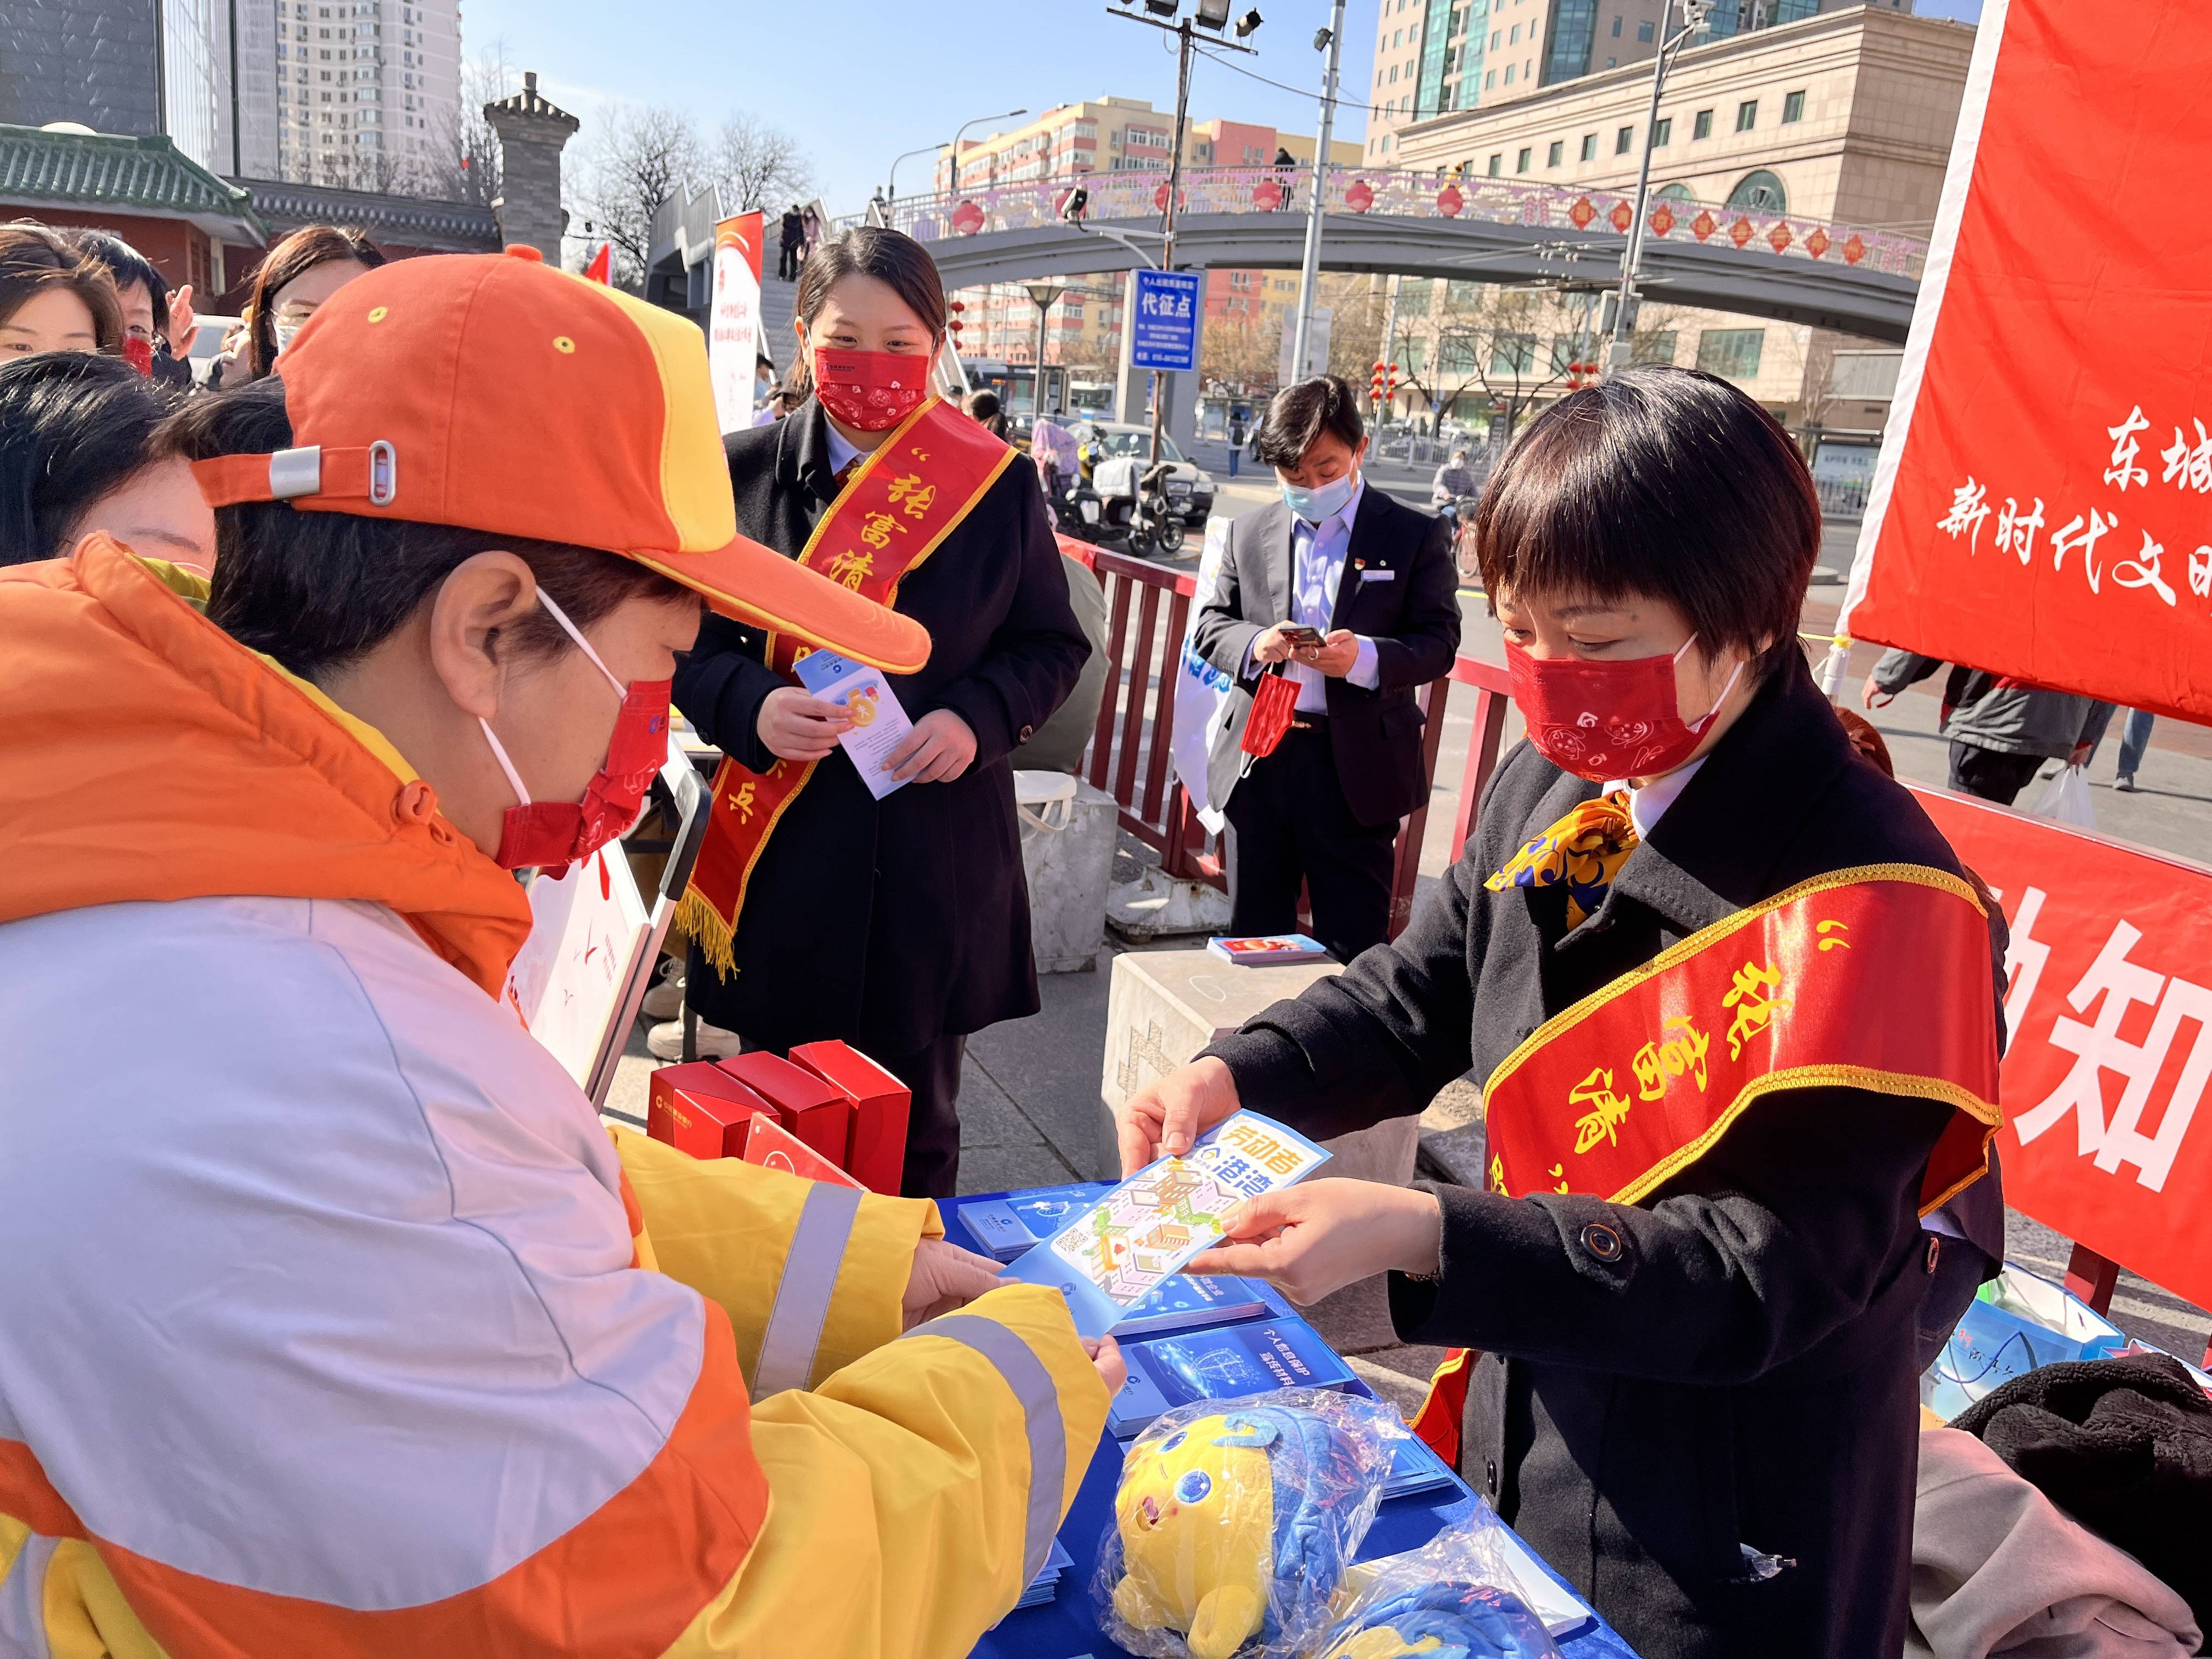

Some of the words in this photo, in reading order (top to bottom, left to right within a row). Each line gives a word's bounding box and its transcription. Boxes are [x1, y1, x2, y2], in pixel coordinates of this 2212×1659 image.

[1142, 292, 1190, 317] 代征点
[1221, 1125, 1304, 1175] 劳动者
[1211, 1155, 1273, 1198] 港湾
[1200, 1276, 1224, 1296] 微企业
[1259, 1352, 1295, 1386] 宣传材料
[1263, 1329, 1310, 1375] 个人信息保护
